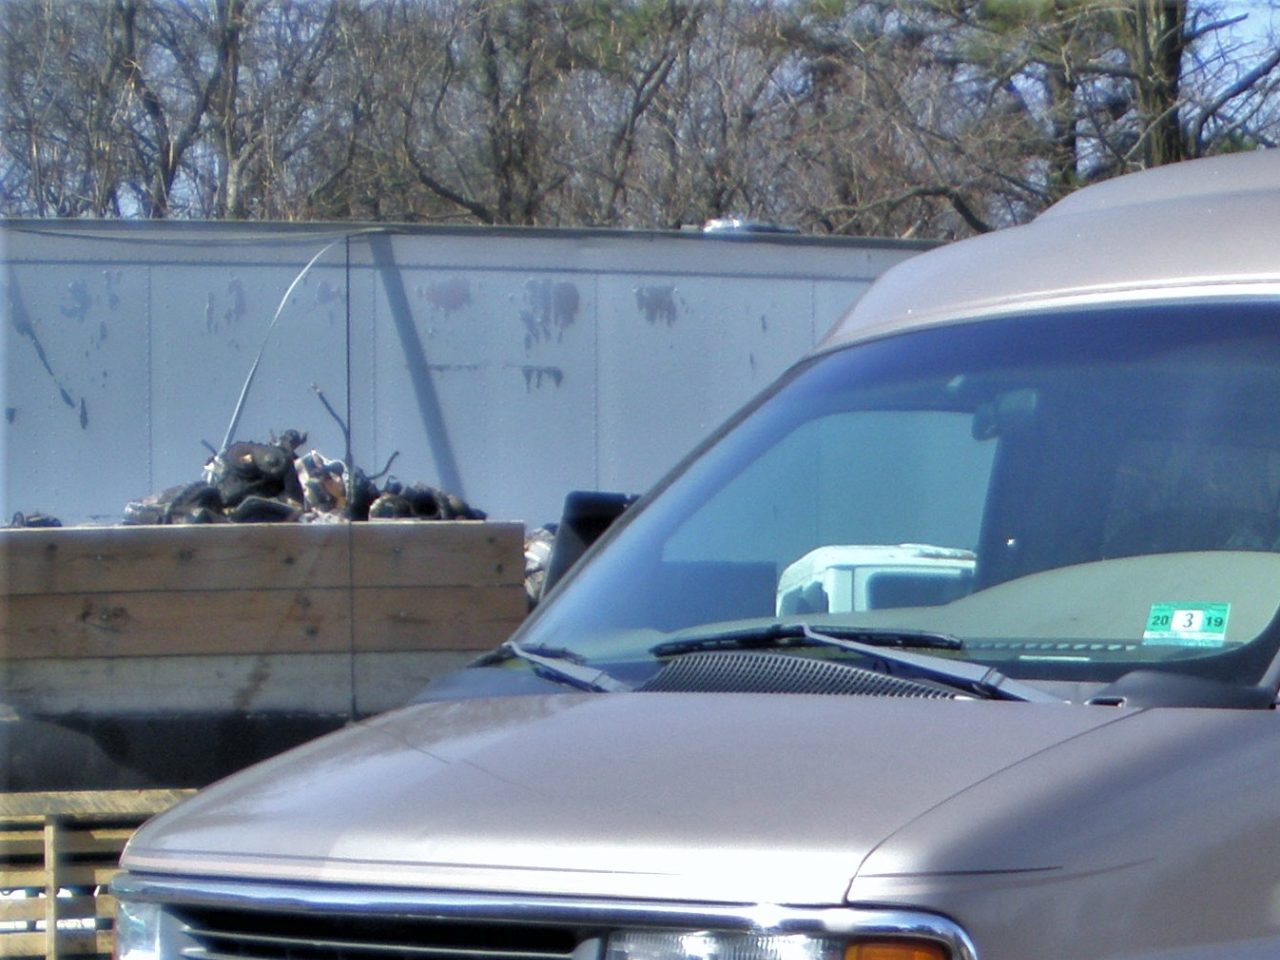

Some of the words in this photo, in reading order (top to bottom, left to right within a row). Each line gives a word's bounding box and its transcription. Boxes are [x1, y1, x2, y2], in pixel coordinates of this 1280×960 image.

[1151, 614, 1170, 626] 20
[1182, 612, 1195, 629] 3
[1205, 616, 1224, 628] 19
